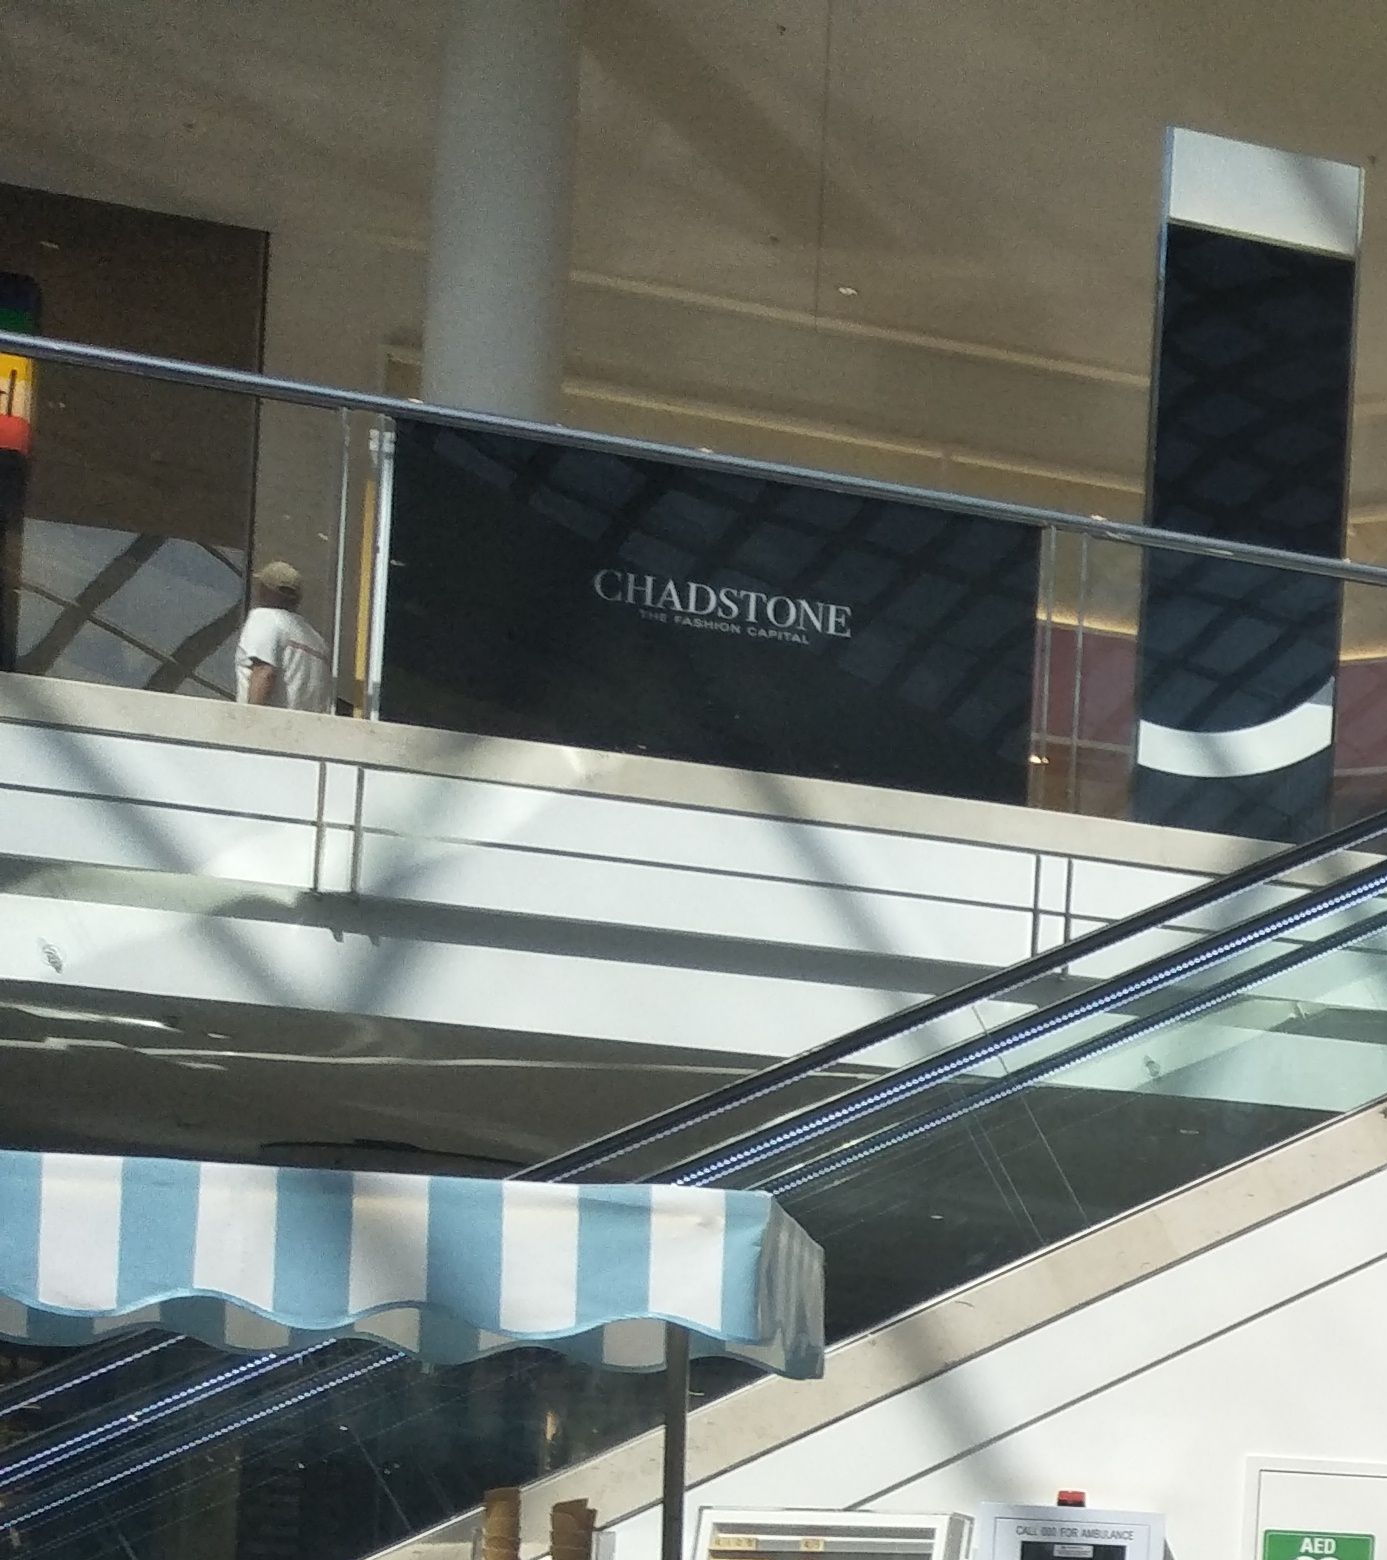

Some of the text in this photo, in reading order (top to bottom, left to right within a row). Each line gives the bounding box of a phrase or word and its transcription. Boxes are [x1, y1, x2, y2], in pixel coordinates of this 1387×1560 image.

[593, 568, 852, 638] CHADSTONE
[638, 608, 810, 646] THE FASHION CAPITAL
[1299, 1537, 1337, 1555] AED
